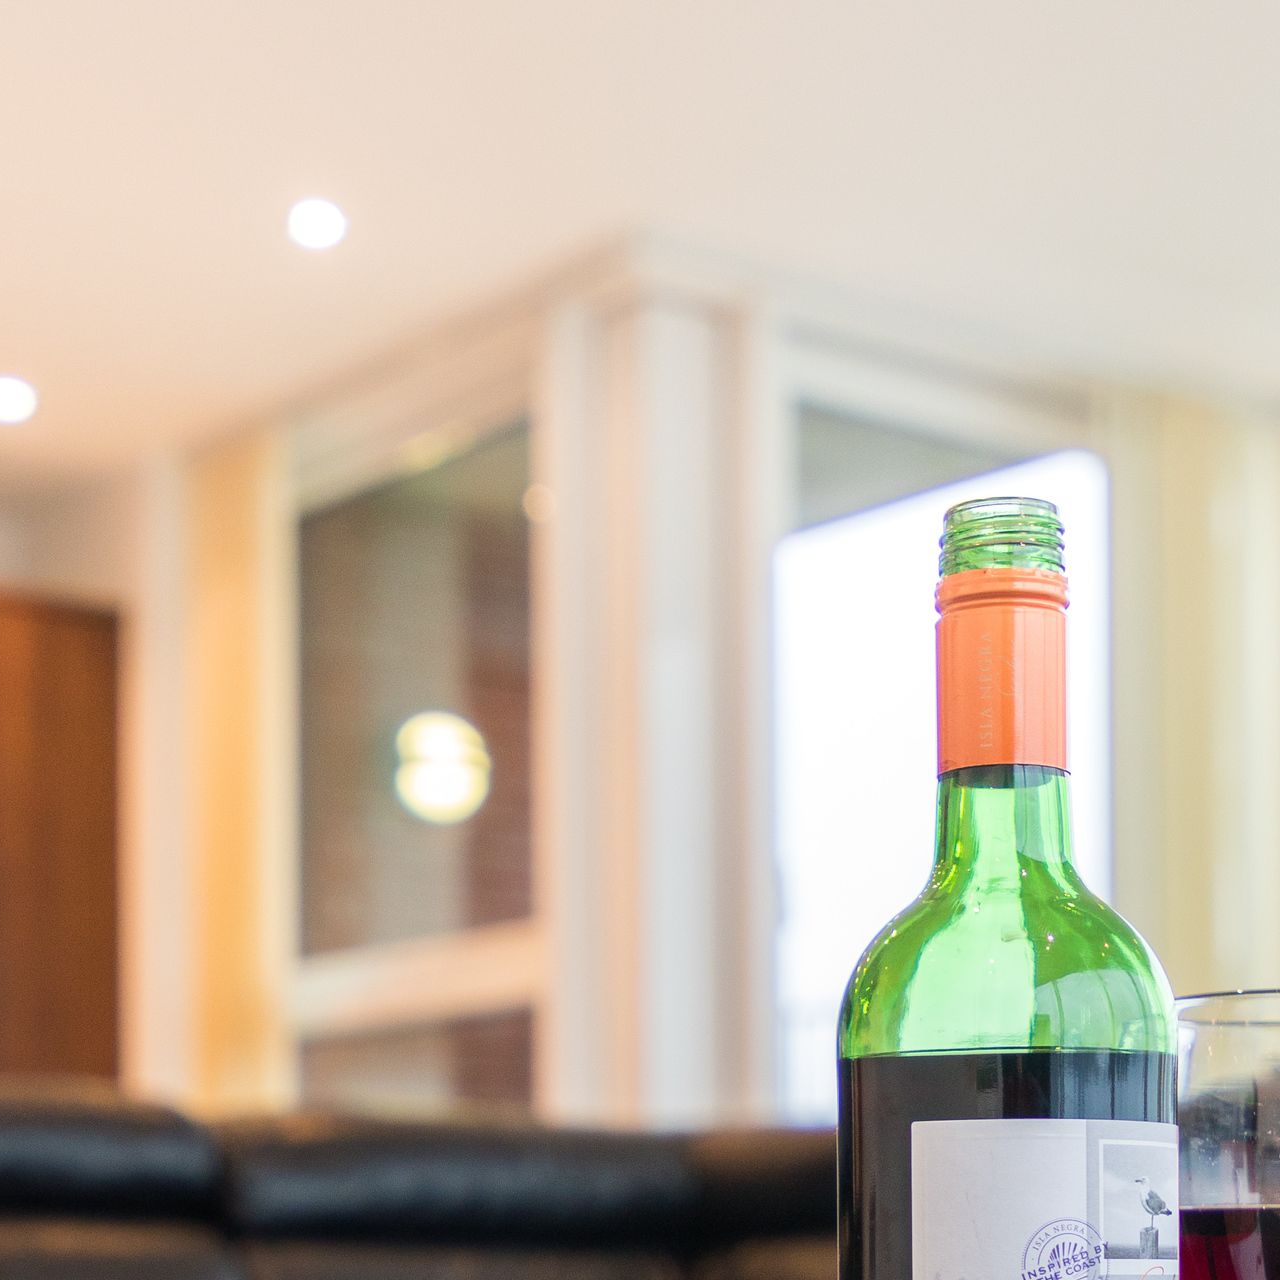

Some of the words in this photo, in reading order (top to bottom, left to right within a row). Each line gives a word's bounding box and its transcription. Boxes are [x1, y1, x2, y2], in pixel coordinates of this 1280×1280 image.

[1032, 1232, 1050, 1251] ISLA
[1053, 1223, 1085, 1235] NEGRA
[1021, 1250, 1089, 1280] INSPIRED
[1093, 1241, 1109, 1255] BY
[1066, 1255, 1102, 1276] COAST
